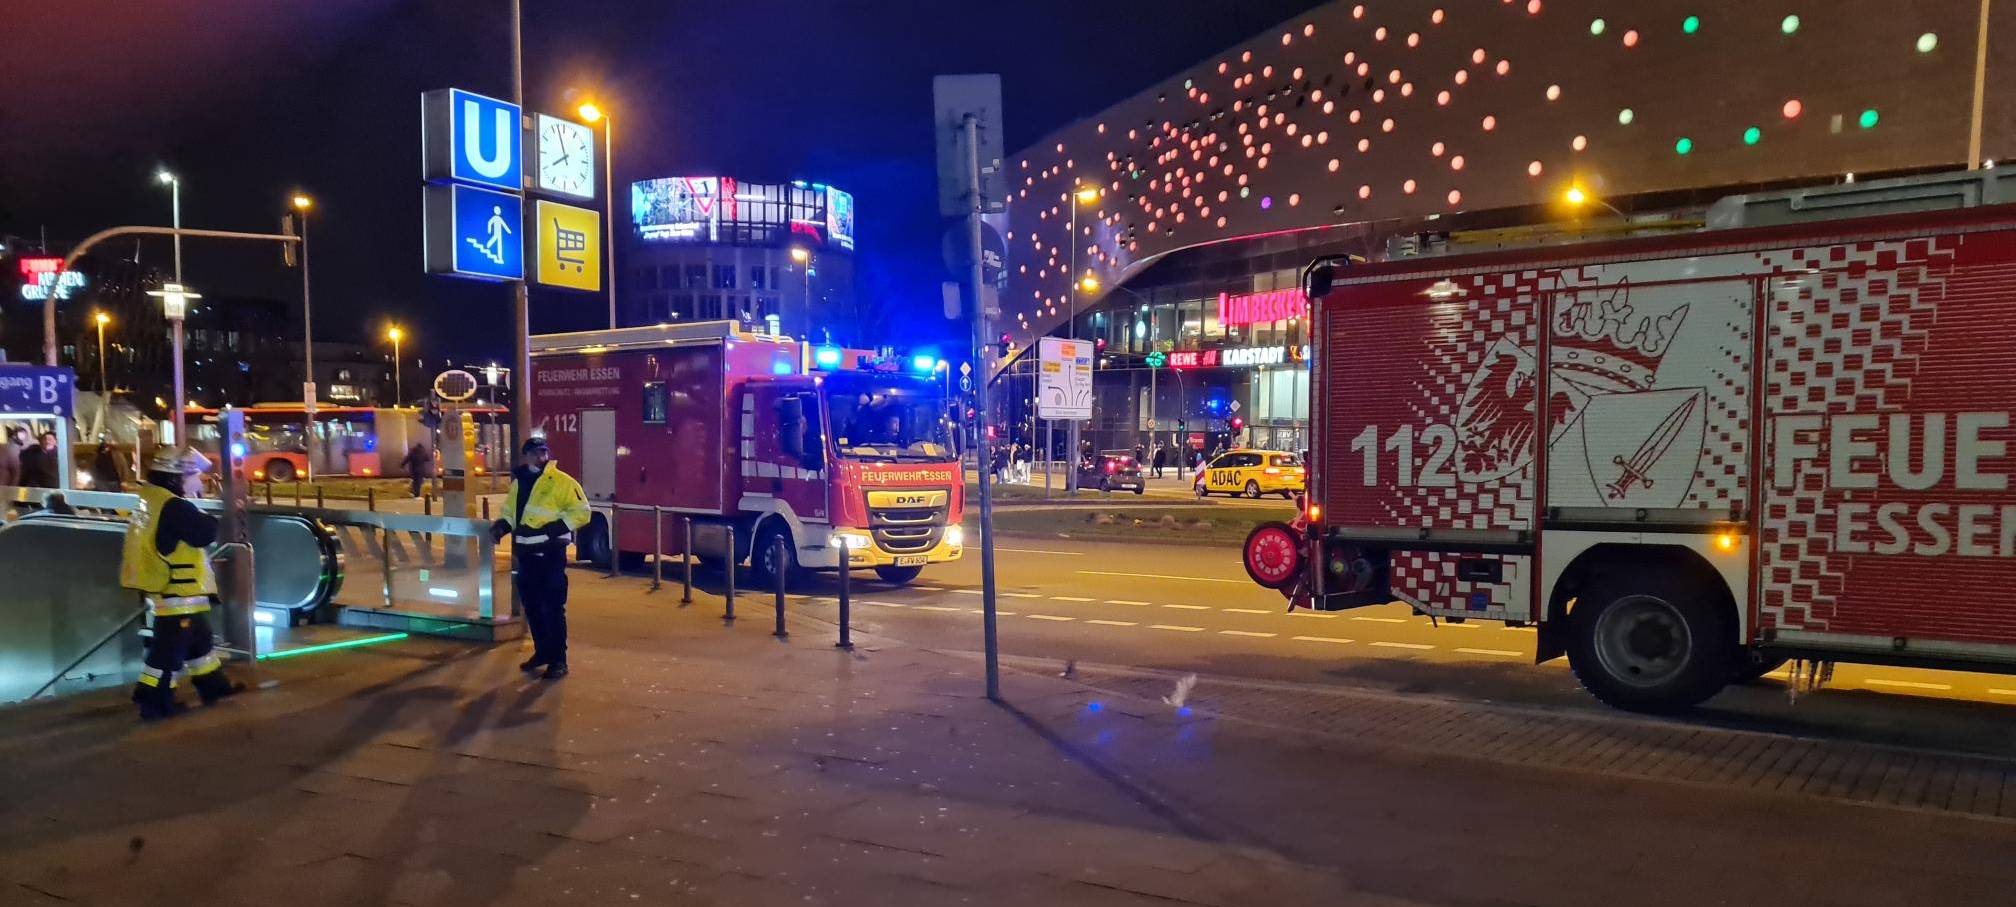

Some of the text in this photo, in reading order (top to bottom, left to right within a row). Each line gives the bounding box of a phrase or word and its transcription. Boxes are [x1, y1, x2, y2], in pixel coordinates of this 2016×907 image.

[464, 100, 511, 178] U
[1170, 352, 1197, 366] REWE
[1223, 347, 1285, 366] KARSTADT
[538, 367, 620, 382] FEUERWEHR ESSEN
[40, 376, 58, 404] B
[554, 413, 577, 432] 112
[1351, 423, 1457, 487] 112
[861, 470, 952, 482] FEUERWEHR ESSEN
[1211, 470, 1242, 486] ADAC
[896, 496, 926, 504] DAF
[1836, 502, 2016, 556] ESSE
